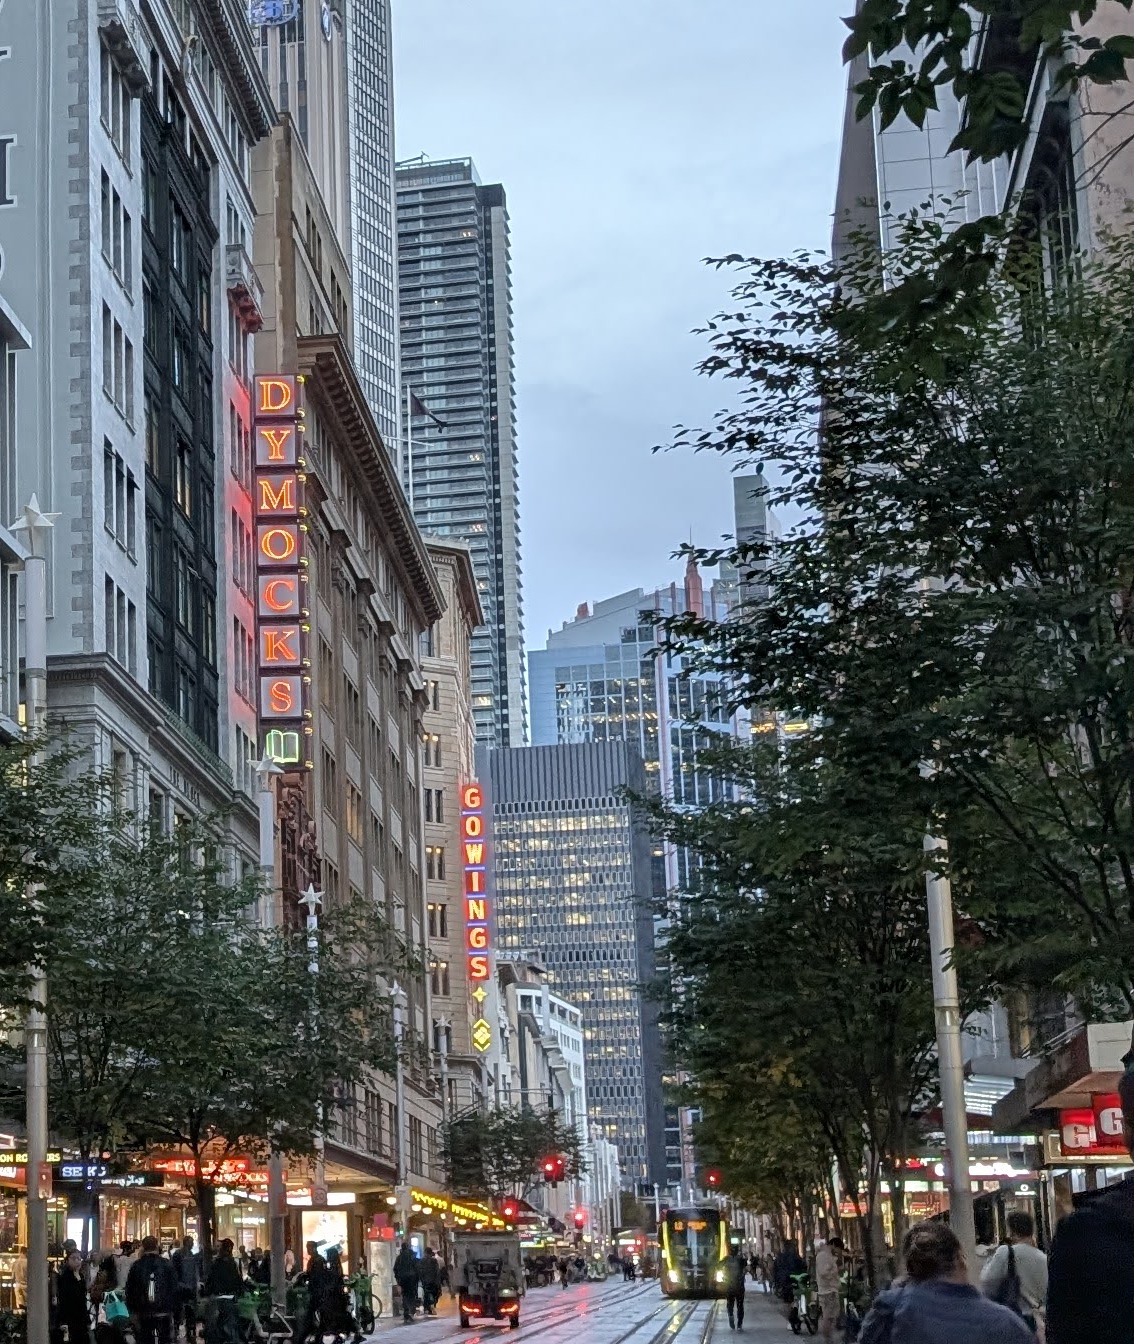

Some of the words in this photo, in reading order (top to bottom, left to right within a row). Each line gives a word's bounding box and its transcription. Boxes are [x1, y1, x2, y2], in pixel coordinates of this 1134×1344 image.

[259, 381, 296, 712] DYMOCKS
[464, 788, 487, 978] GOWINGS
[15, 1153, 61, 1163] ROERS
[61, 1166, 106, 1177] SEKO
